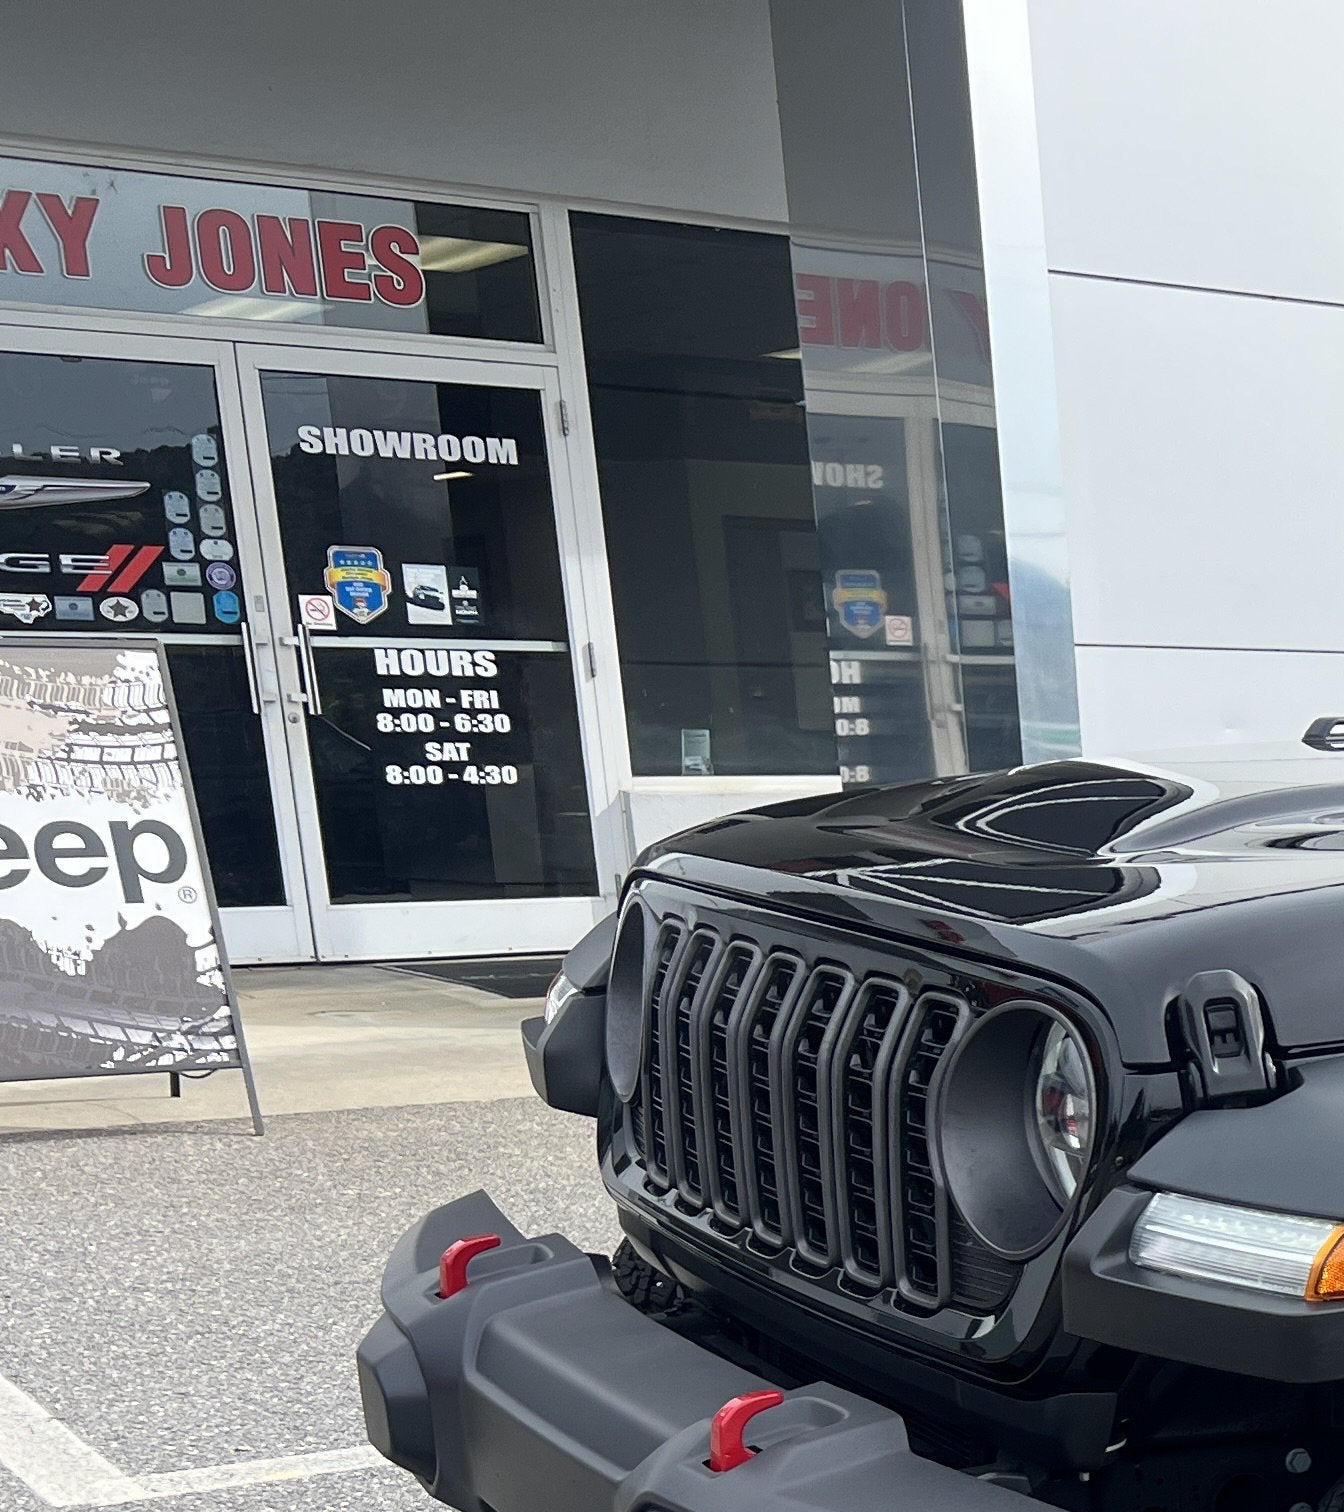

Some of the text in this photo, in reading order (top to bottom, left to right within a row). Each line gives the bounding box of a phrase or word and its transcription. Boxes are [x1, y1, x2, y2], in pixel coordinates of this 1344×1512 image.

[143, 204, 426, 308] JONES
[12, 443, 124, 466] LER
[299, 425, 519, 466] SHOWROOM
[374, 648, 498, 678] HOURS
[382, 688, 440, 709] MON
[459, 689, 500, 710] FRI
[376, 712, 434, 733] 8:00
[454, 713, 511, 734] 6:30
[424, 741, 472, 762] SAT
[385, 765, 444, 786] 8:00
[462, 765, 518, 786] 4:30
